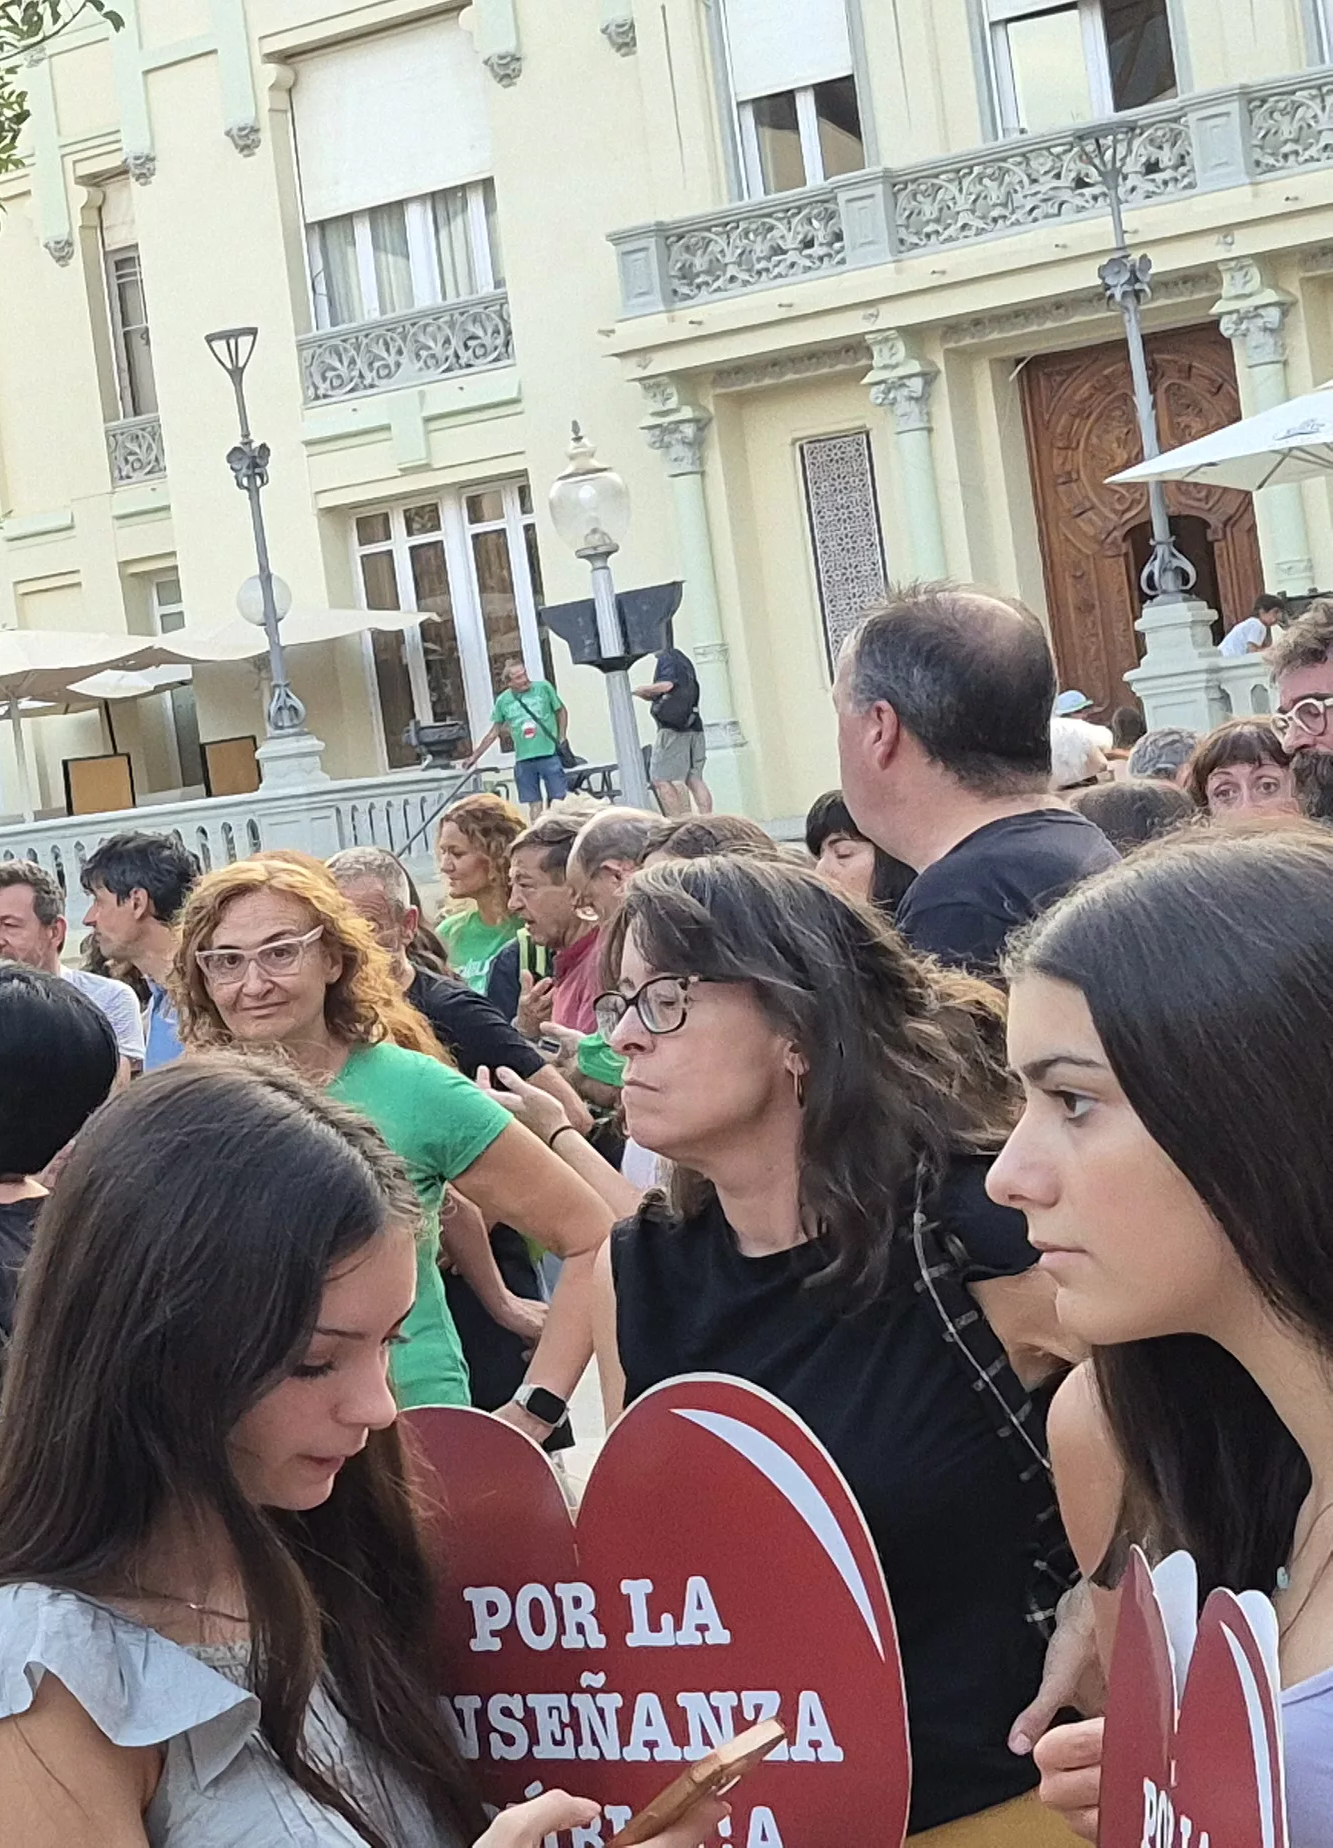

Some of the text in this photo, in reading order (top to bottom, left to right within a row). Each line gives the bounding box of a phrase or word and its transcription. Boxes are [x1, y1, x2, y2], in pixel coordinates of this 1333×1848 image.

[463, 1576, 732, 1652] POR LA
[441, 1671, 844, 1762] NSEÑANZA
